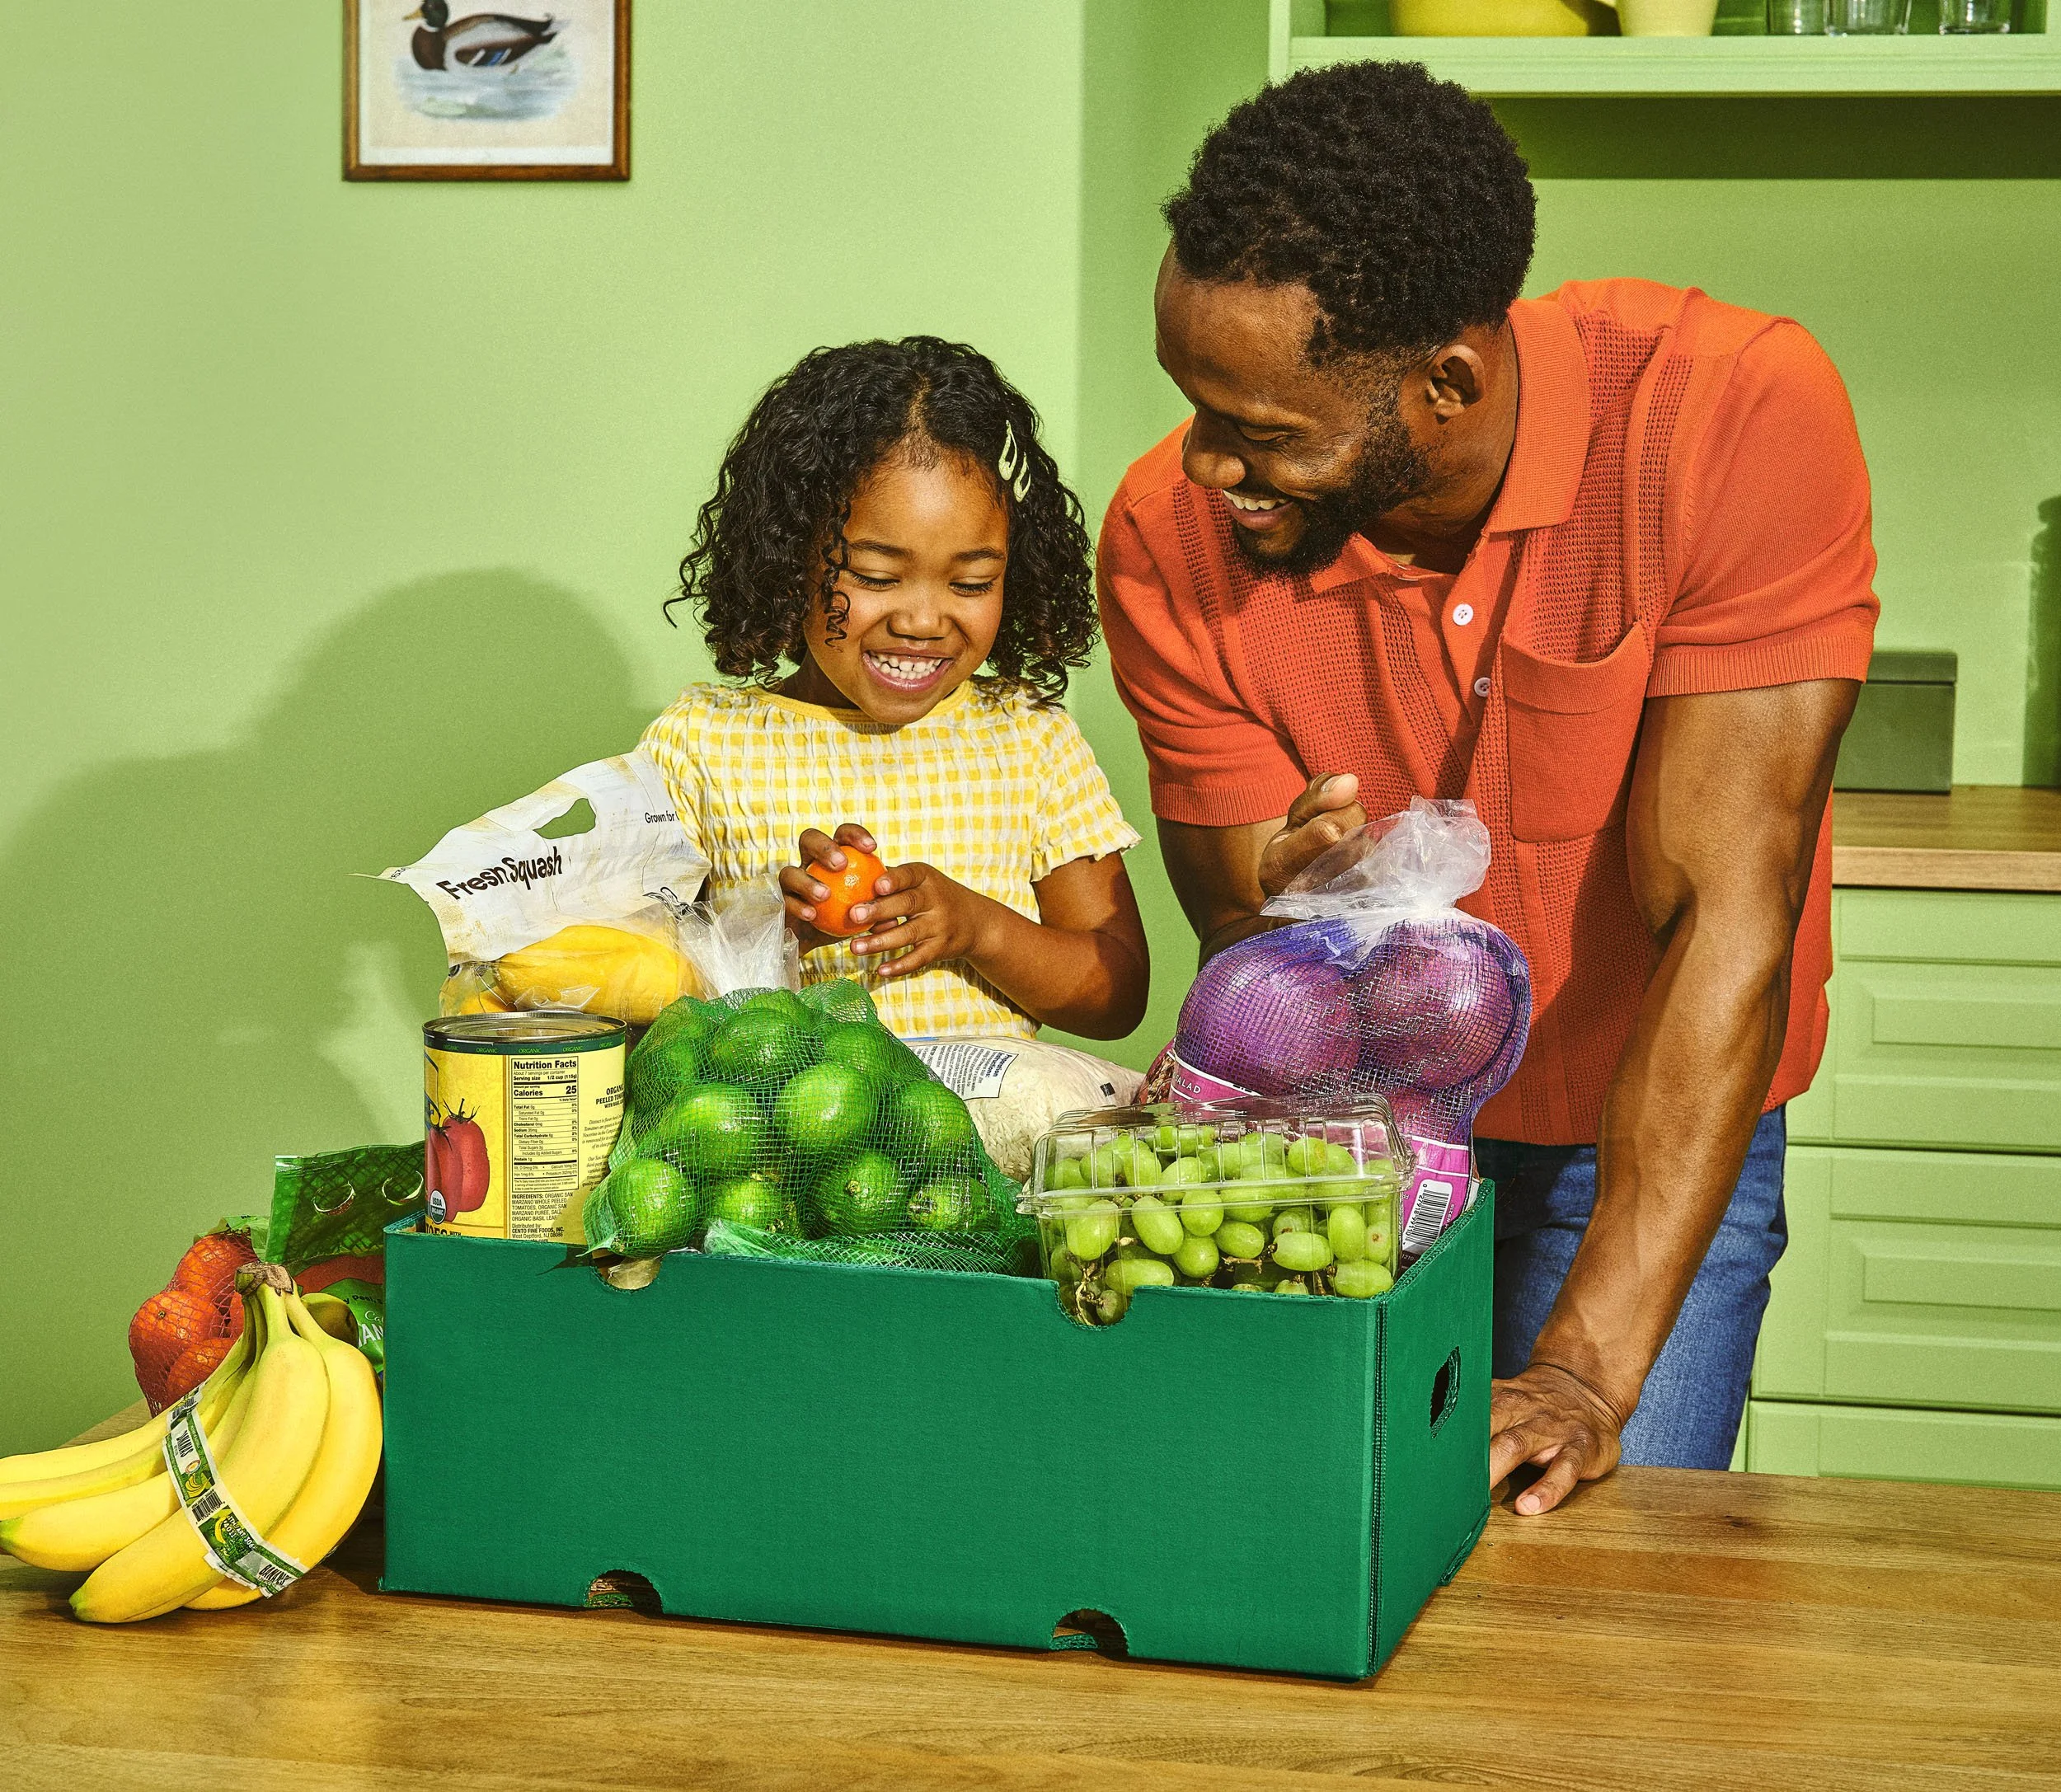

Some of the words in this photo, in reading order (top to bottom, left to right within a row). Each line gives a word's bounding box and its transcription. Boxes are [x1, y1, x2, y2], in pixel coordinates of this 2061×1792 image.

[645, 812, 666, 823] Grown
[666, 810, 674, 821] for
[514, 1061, 552, 1069] Nutrition
[555, 1060, 577, 1068] Facts
[1174, 1074, 1201, 1094] SALAD
[566, 1085, 577, 1095] 25
[595, 1095, 613, 1105] PEELED
[433, 1197, 443, 1207] USDA
[258, 1564, 292, 1586] BANANAS
